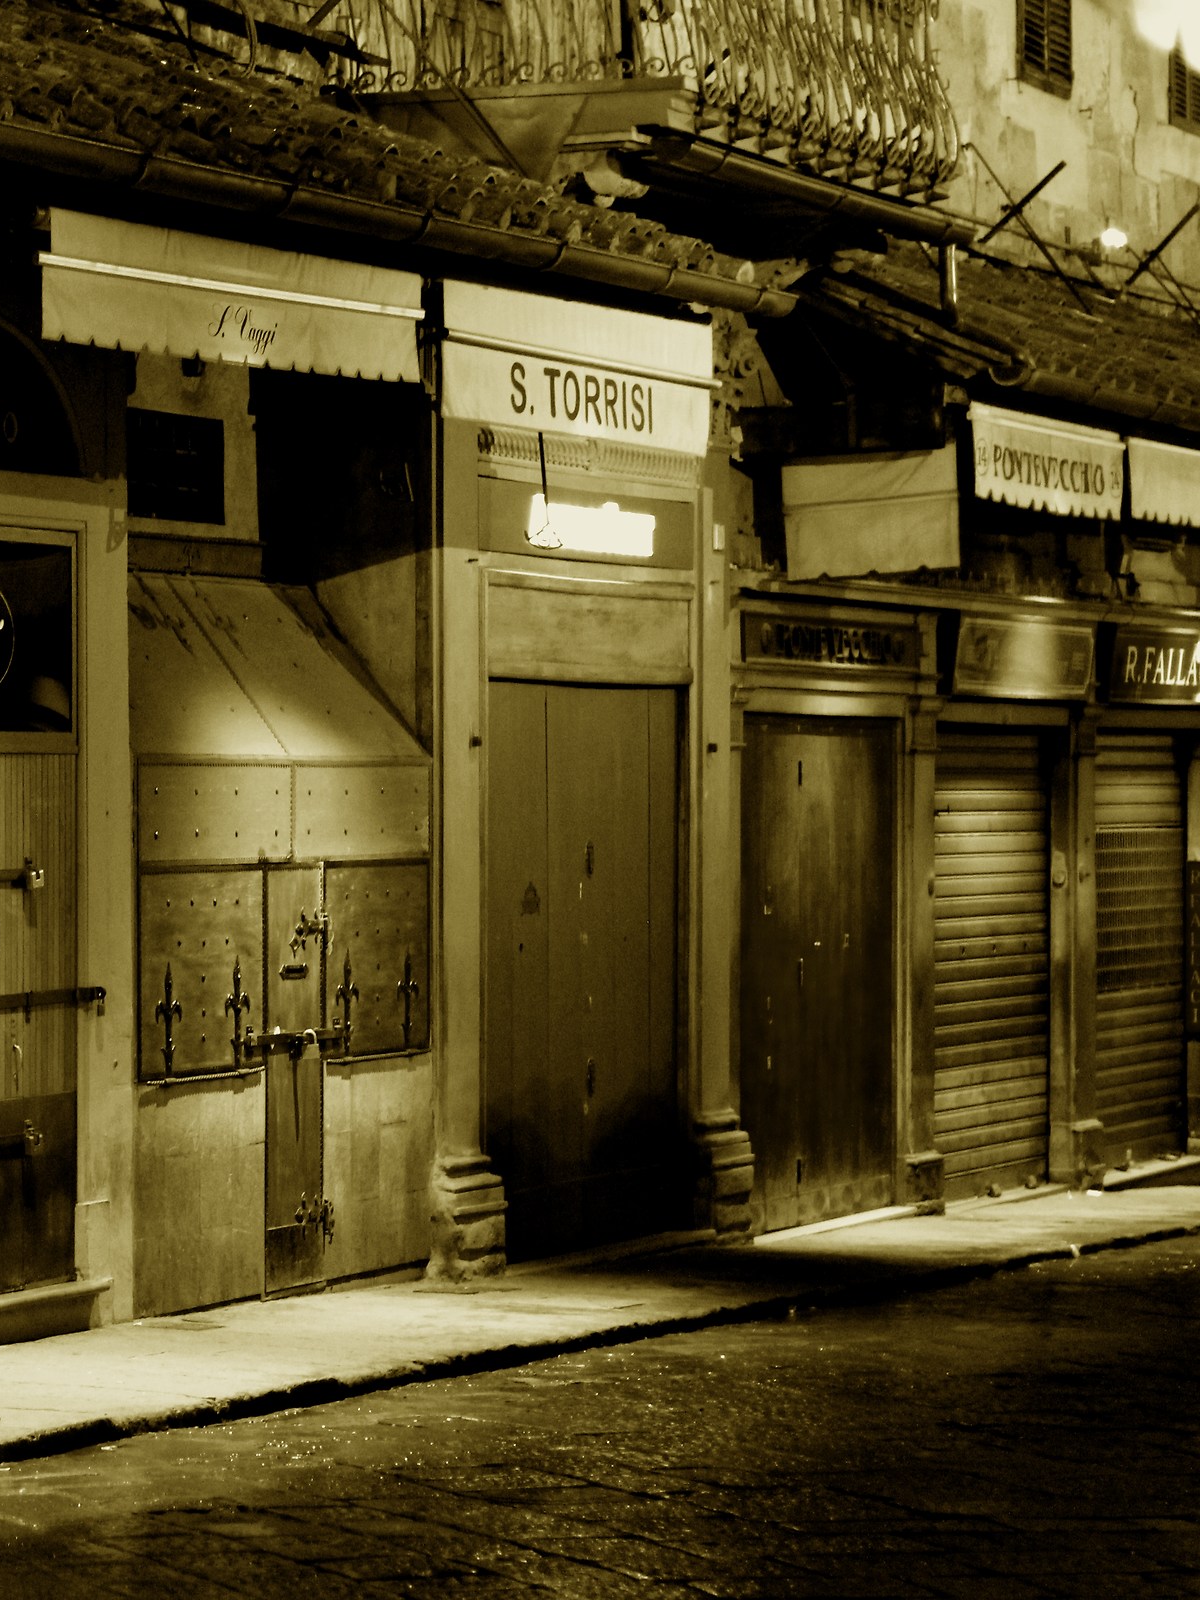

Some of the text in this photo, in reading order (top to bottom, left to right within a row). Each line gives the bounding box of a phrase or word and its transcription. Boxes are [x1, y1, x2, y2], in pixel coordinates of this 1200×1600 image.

[208, 303, 278, 355] S. Vaggi
[510, 361, 653, 434] S. TORRISI
[993, 444, 1105, 496] PONTEVECCHIO
